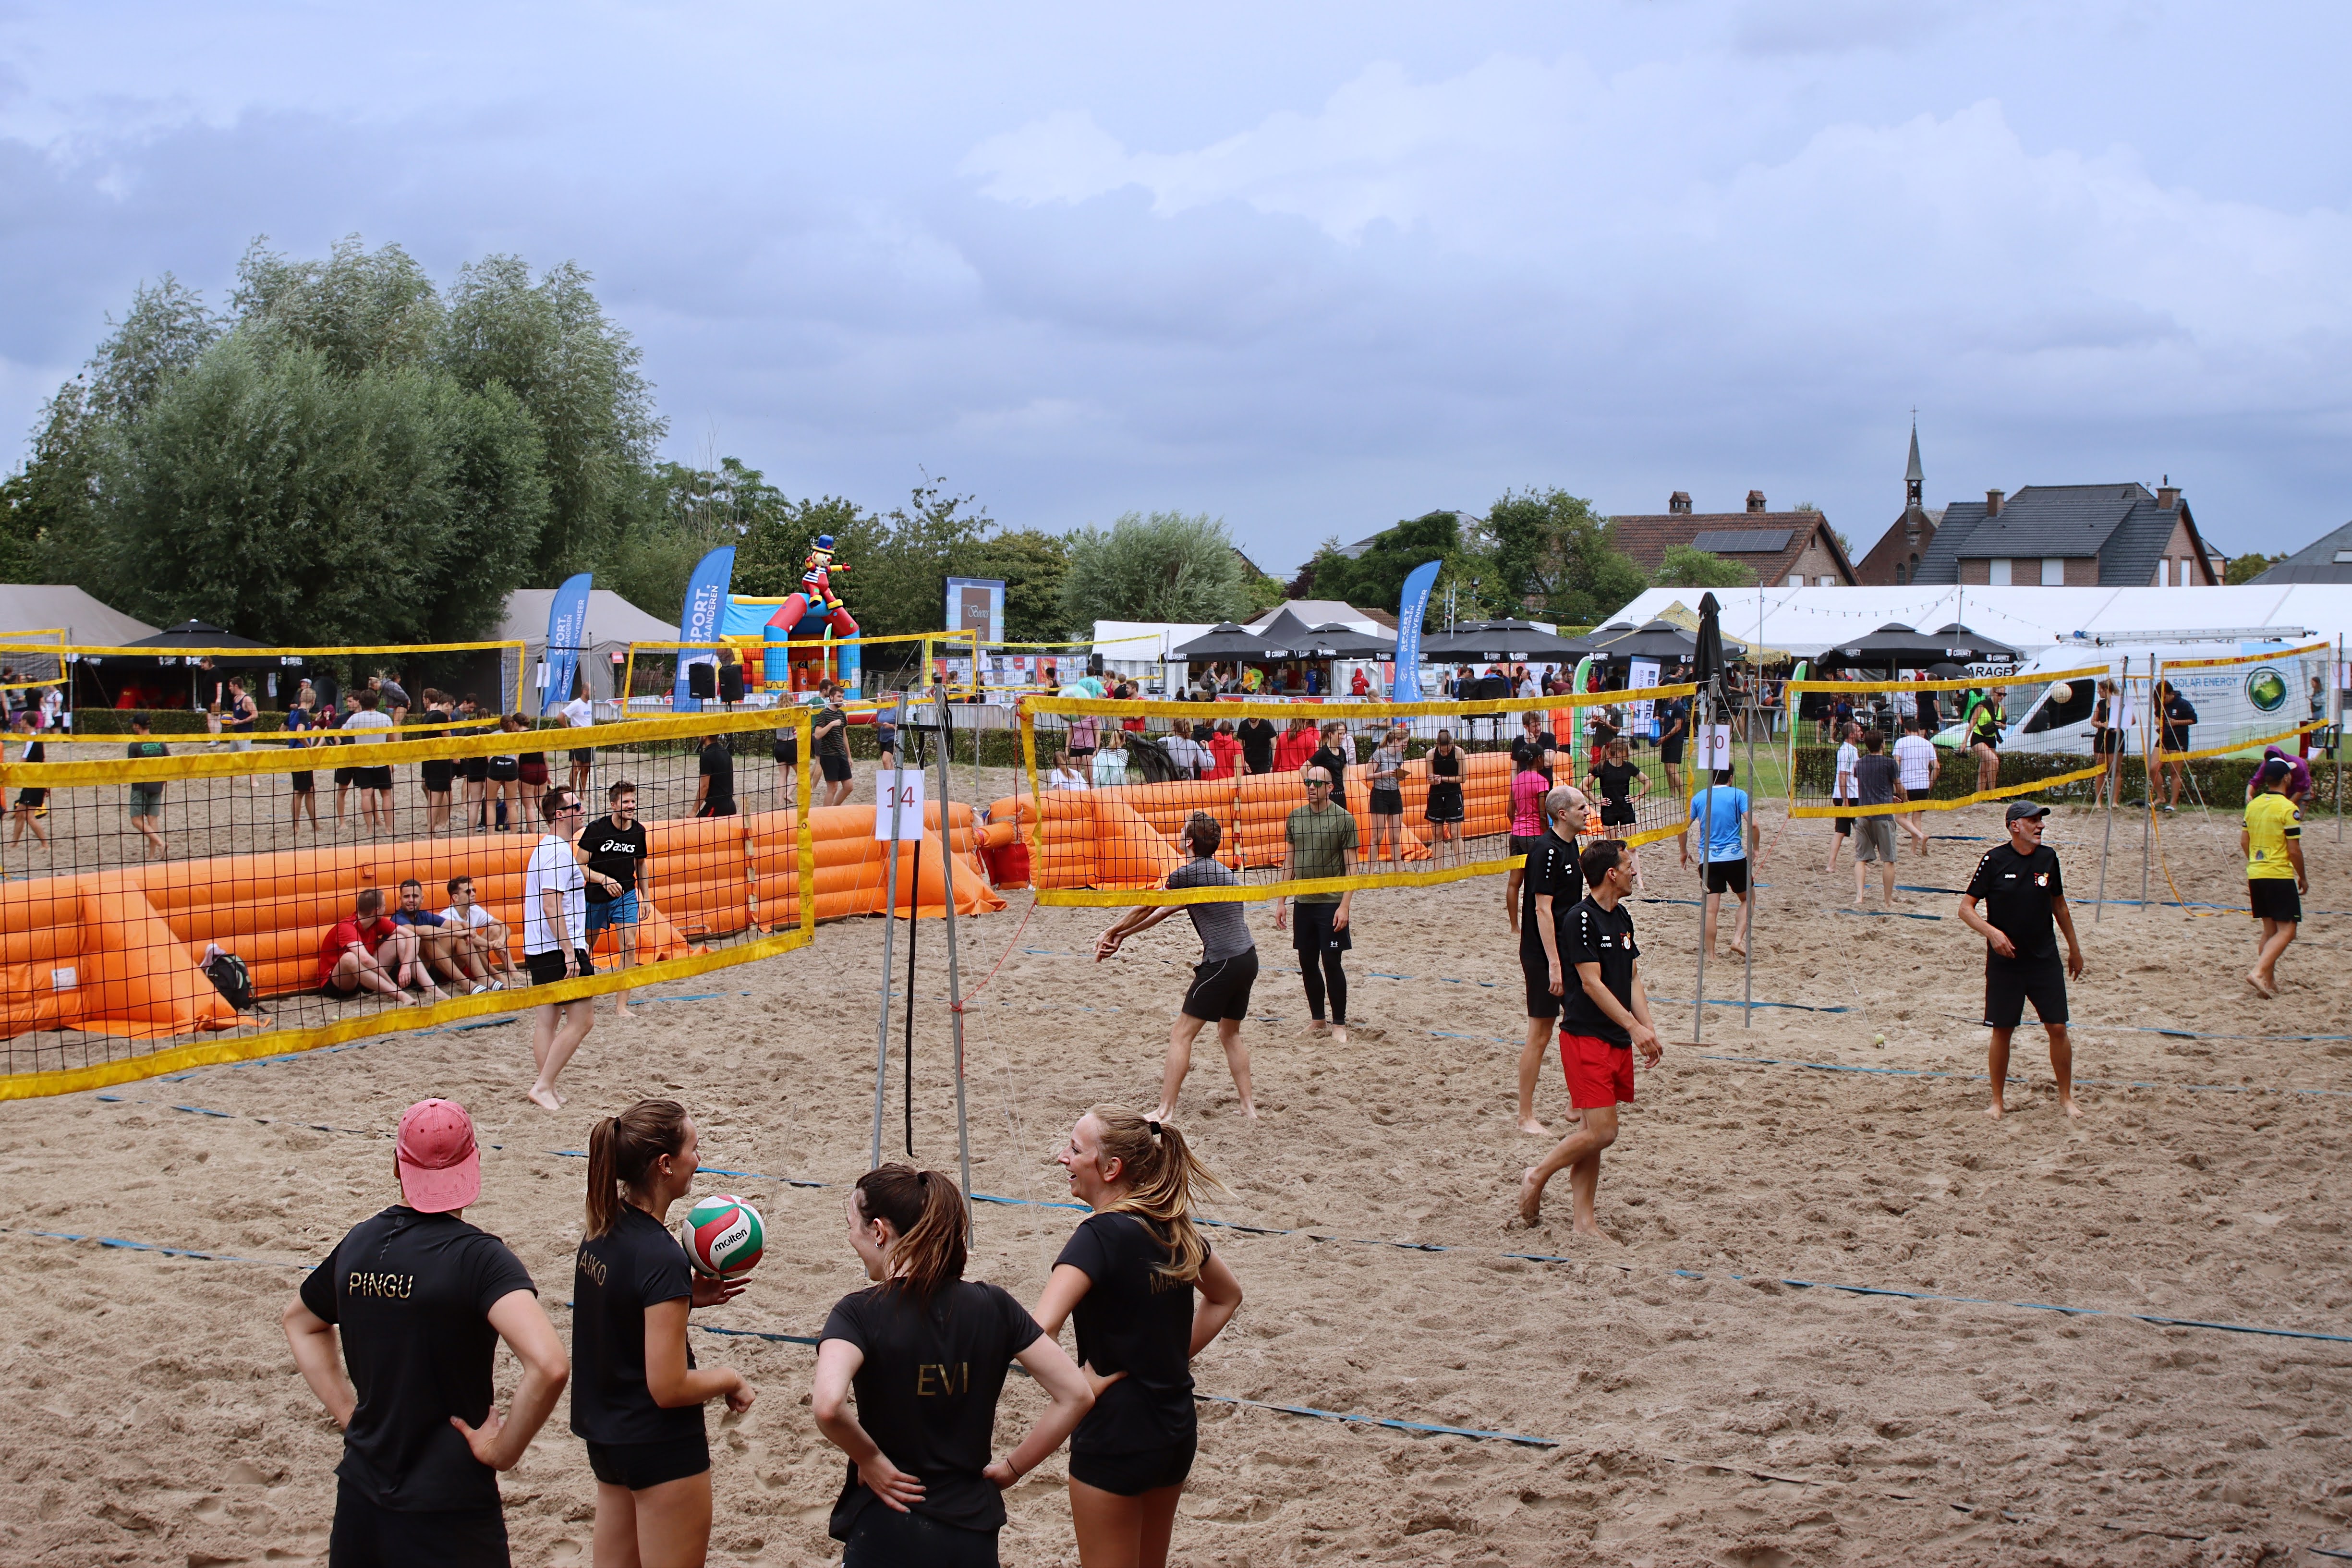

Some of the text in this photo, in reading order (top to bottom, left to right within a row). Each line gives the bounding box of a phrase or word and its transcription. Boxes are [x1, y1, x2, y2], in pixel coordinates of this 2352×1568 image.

[690, 584, 711, 642] PORT.
[703, 585, 719, 642] LAANDEREN
[1953, 649, 1972, 657] CORNET
[1969, 666, 2014, 677] ARAGE
[2173, 677, 2237, 688] SOLAR ENERGY
[1705, 735, 1724, 749] 10
[887, 786, 915, 808] 14
[714, 1229, 748, 1252] molten
[579, 1250, 607, 1286] AIKO
[350, 1272, 414, 1299] PINGU
[917, 1362, 968, 1396] EVI
